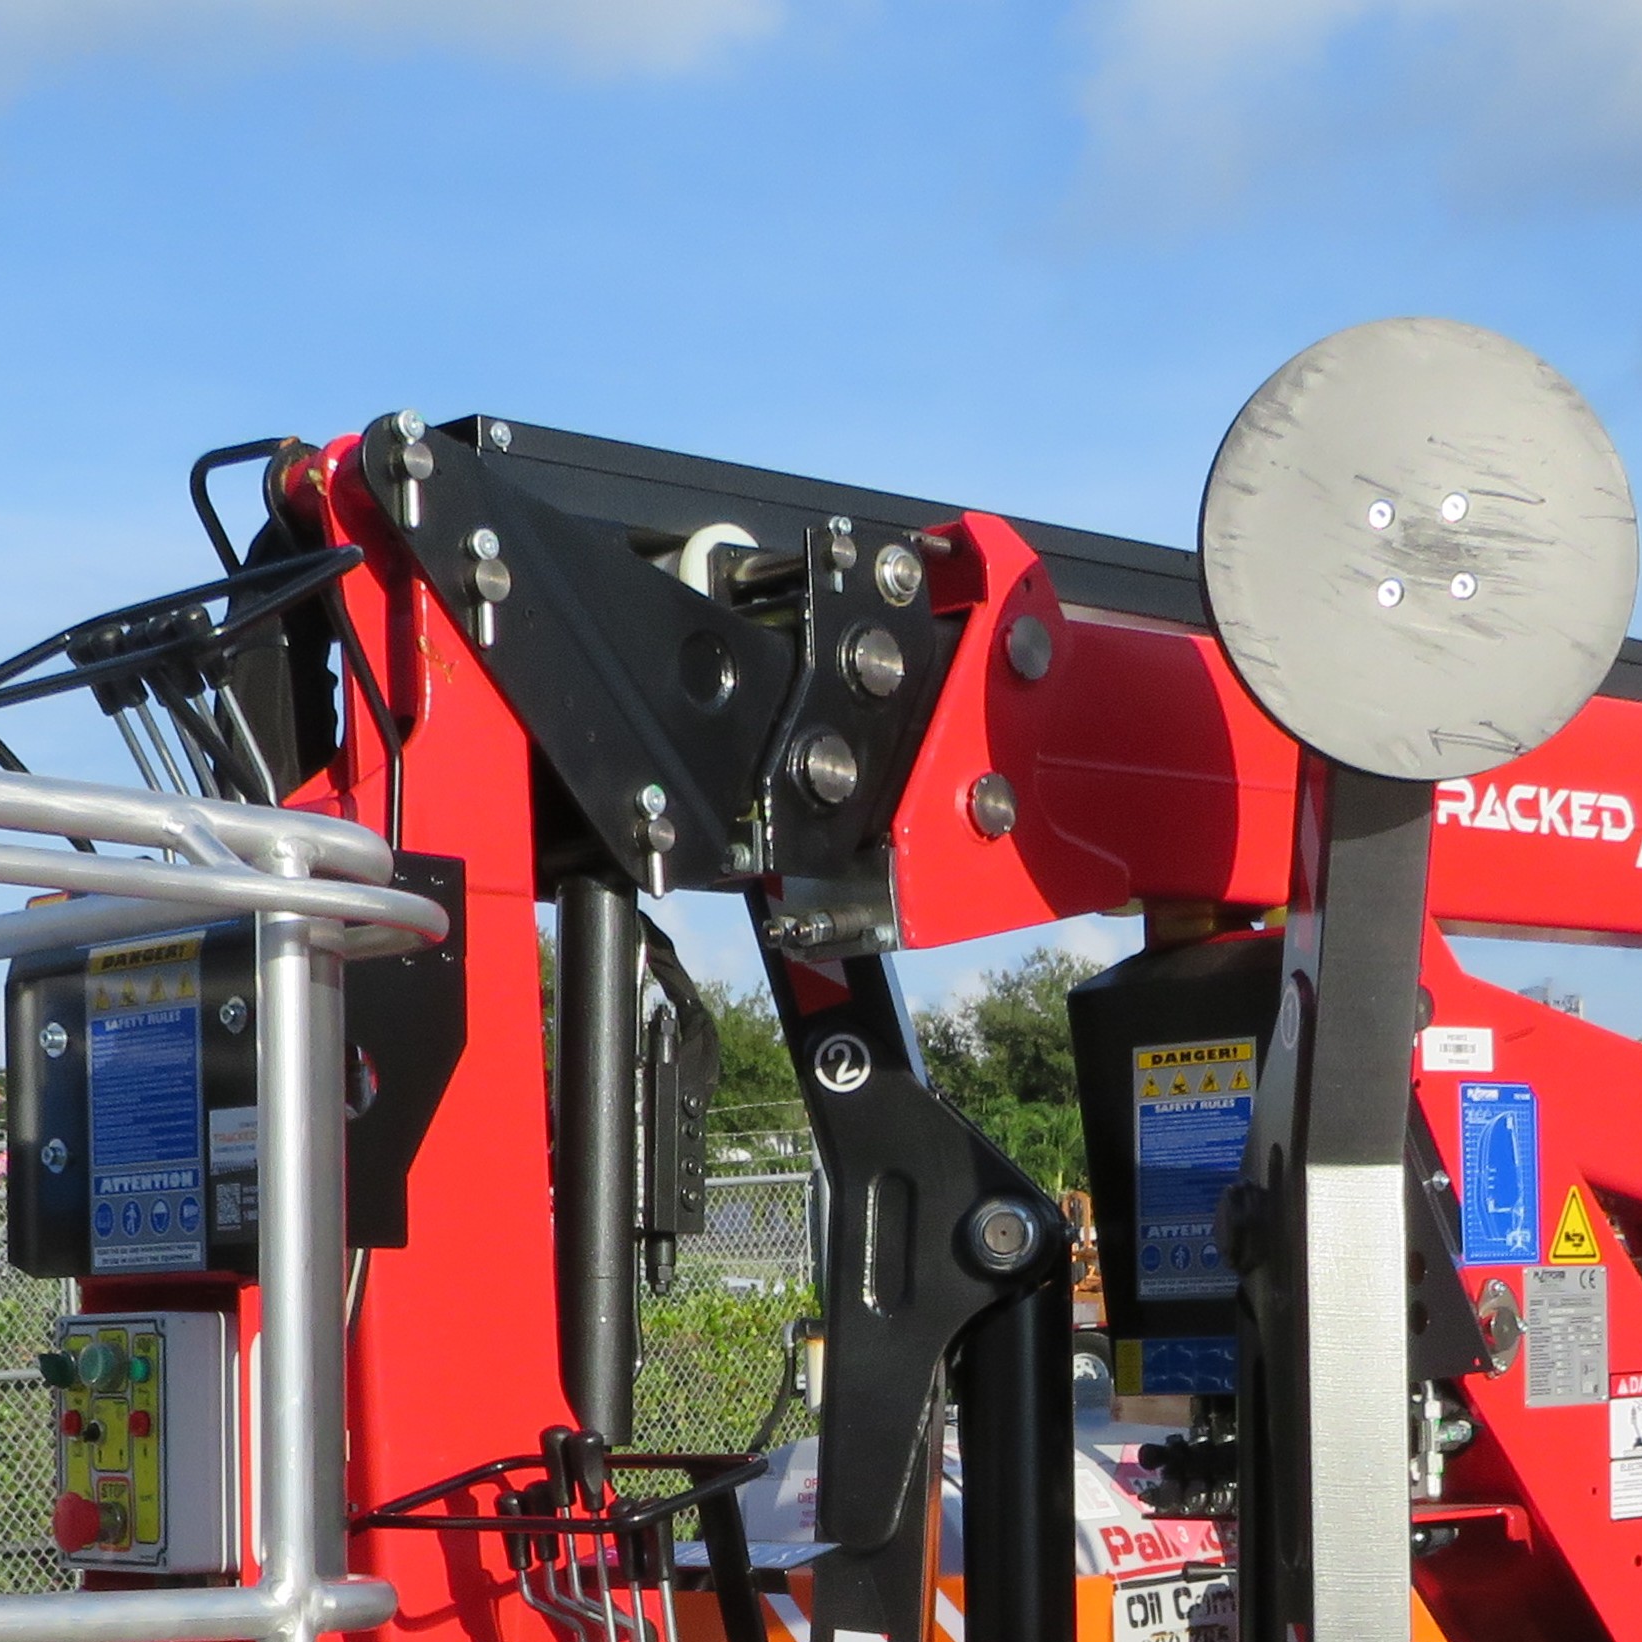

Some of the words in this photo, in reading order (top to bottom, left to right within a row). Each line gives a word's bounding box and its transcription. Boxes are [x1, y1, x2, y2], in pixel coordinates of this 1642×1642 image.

[1436, 778, 1635, 842] RACKED
[1151, 1047, 1238, 1066] DANGER!
[1154, 1101, 1197, 1114] SAFETY
[1199, 1098, 1236, 1110] RULES
[100, 1170, 194, 1194] ATTENTION
[1147, 1223, 1214, 1239] ATTENT
[1126, 1591, 1163, 1629] Oil
